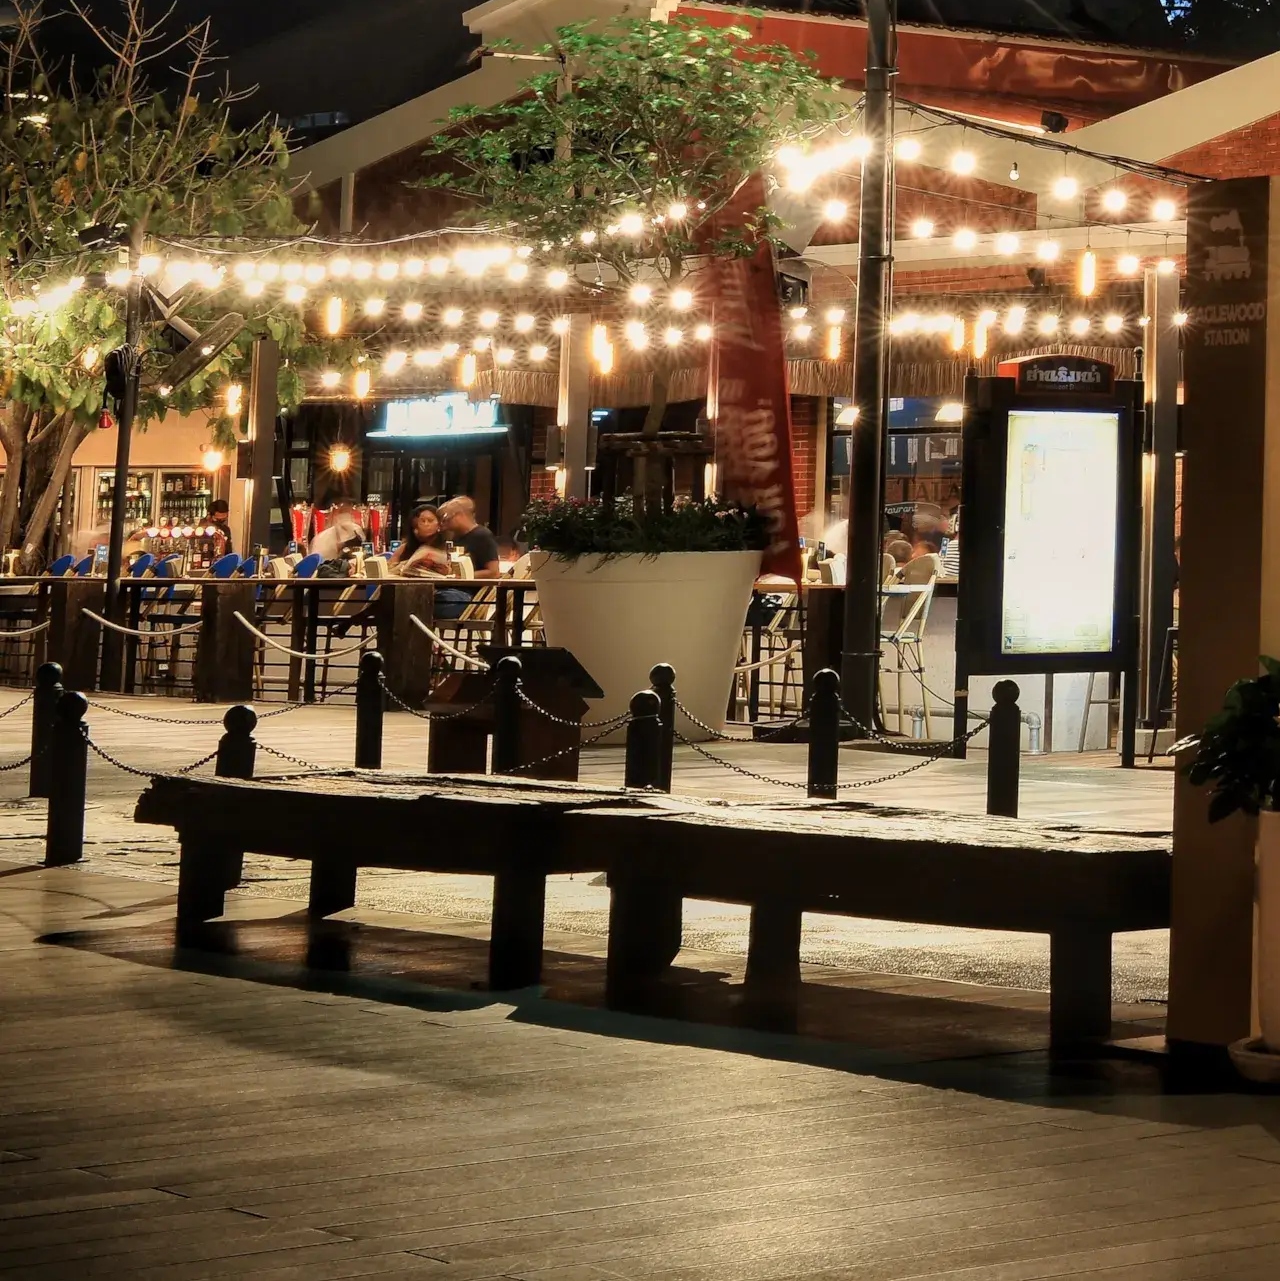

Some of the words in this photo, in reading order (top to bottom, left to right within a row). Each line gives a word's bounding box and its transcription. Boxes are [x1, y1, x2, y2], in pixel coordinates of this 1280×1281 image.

[1190, 302, 1266, 324] AGLEWOOD
[1204, 328, 1250, 346] STATION
[884, 506, 918, 514] taurant
